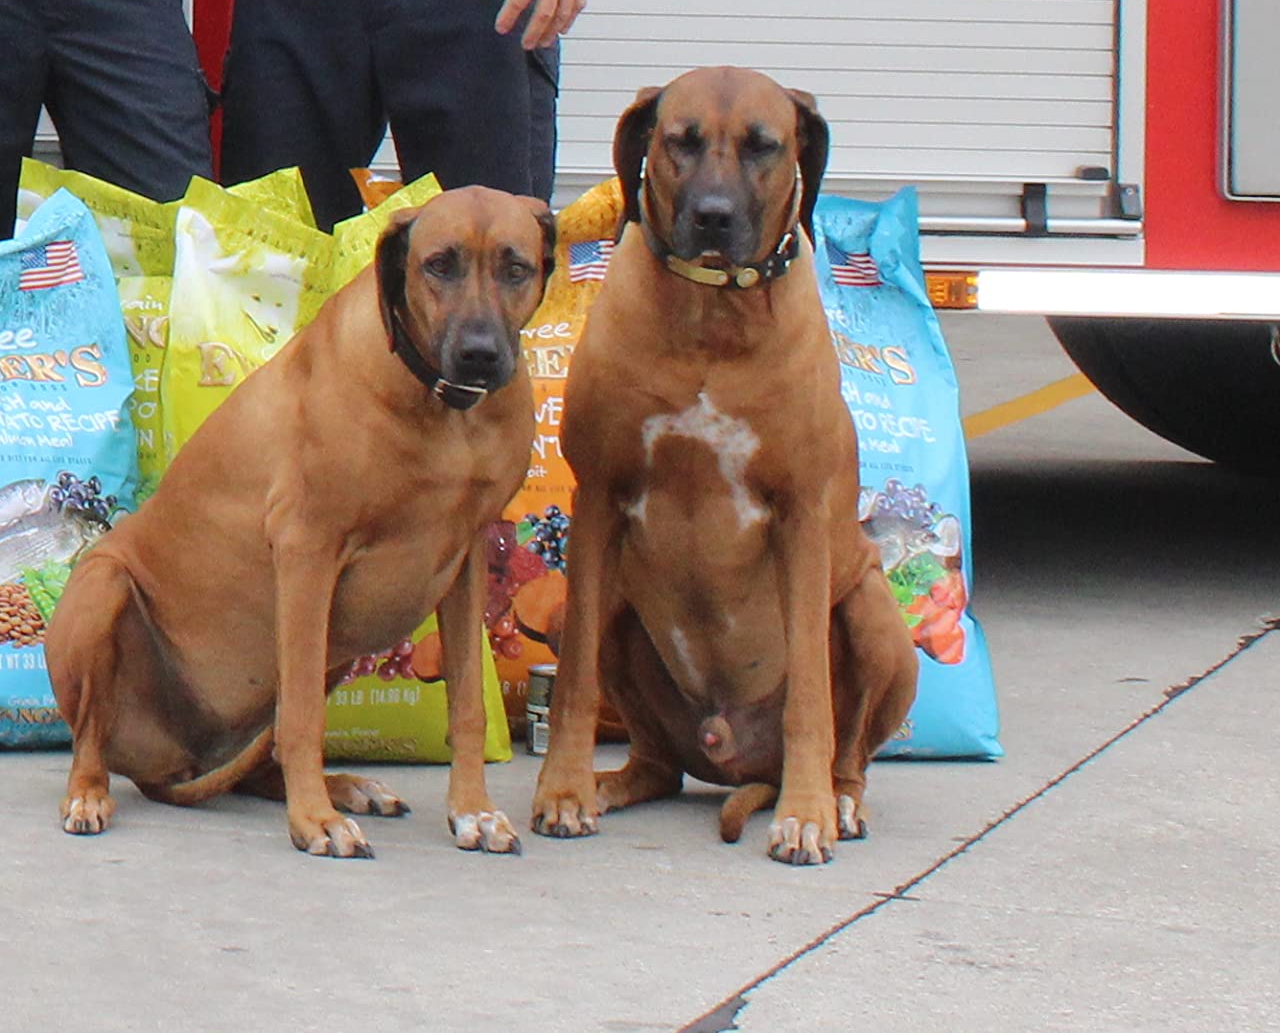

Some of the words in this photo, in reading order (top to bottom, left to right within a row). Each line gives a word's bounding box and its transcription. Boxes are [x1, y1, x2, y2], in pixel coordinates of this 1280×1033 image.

[520, 321, 571, 339] ree
[29, 398, 72, 413] and
[36, 433, 74, 449] Meal
[22, 653, 35, 670] 33
